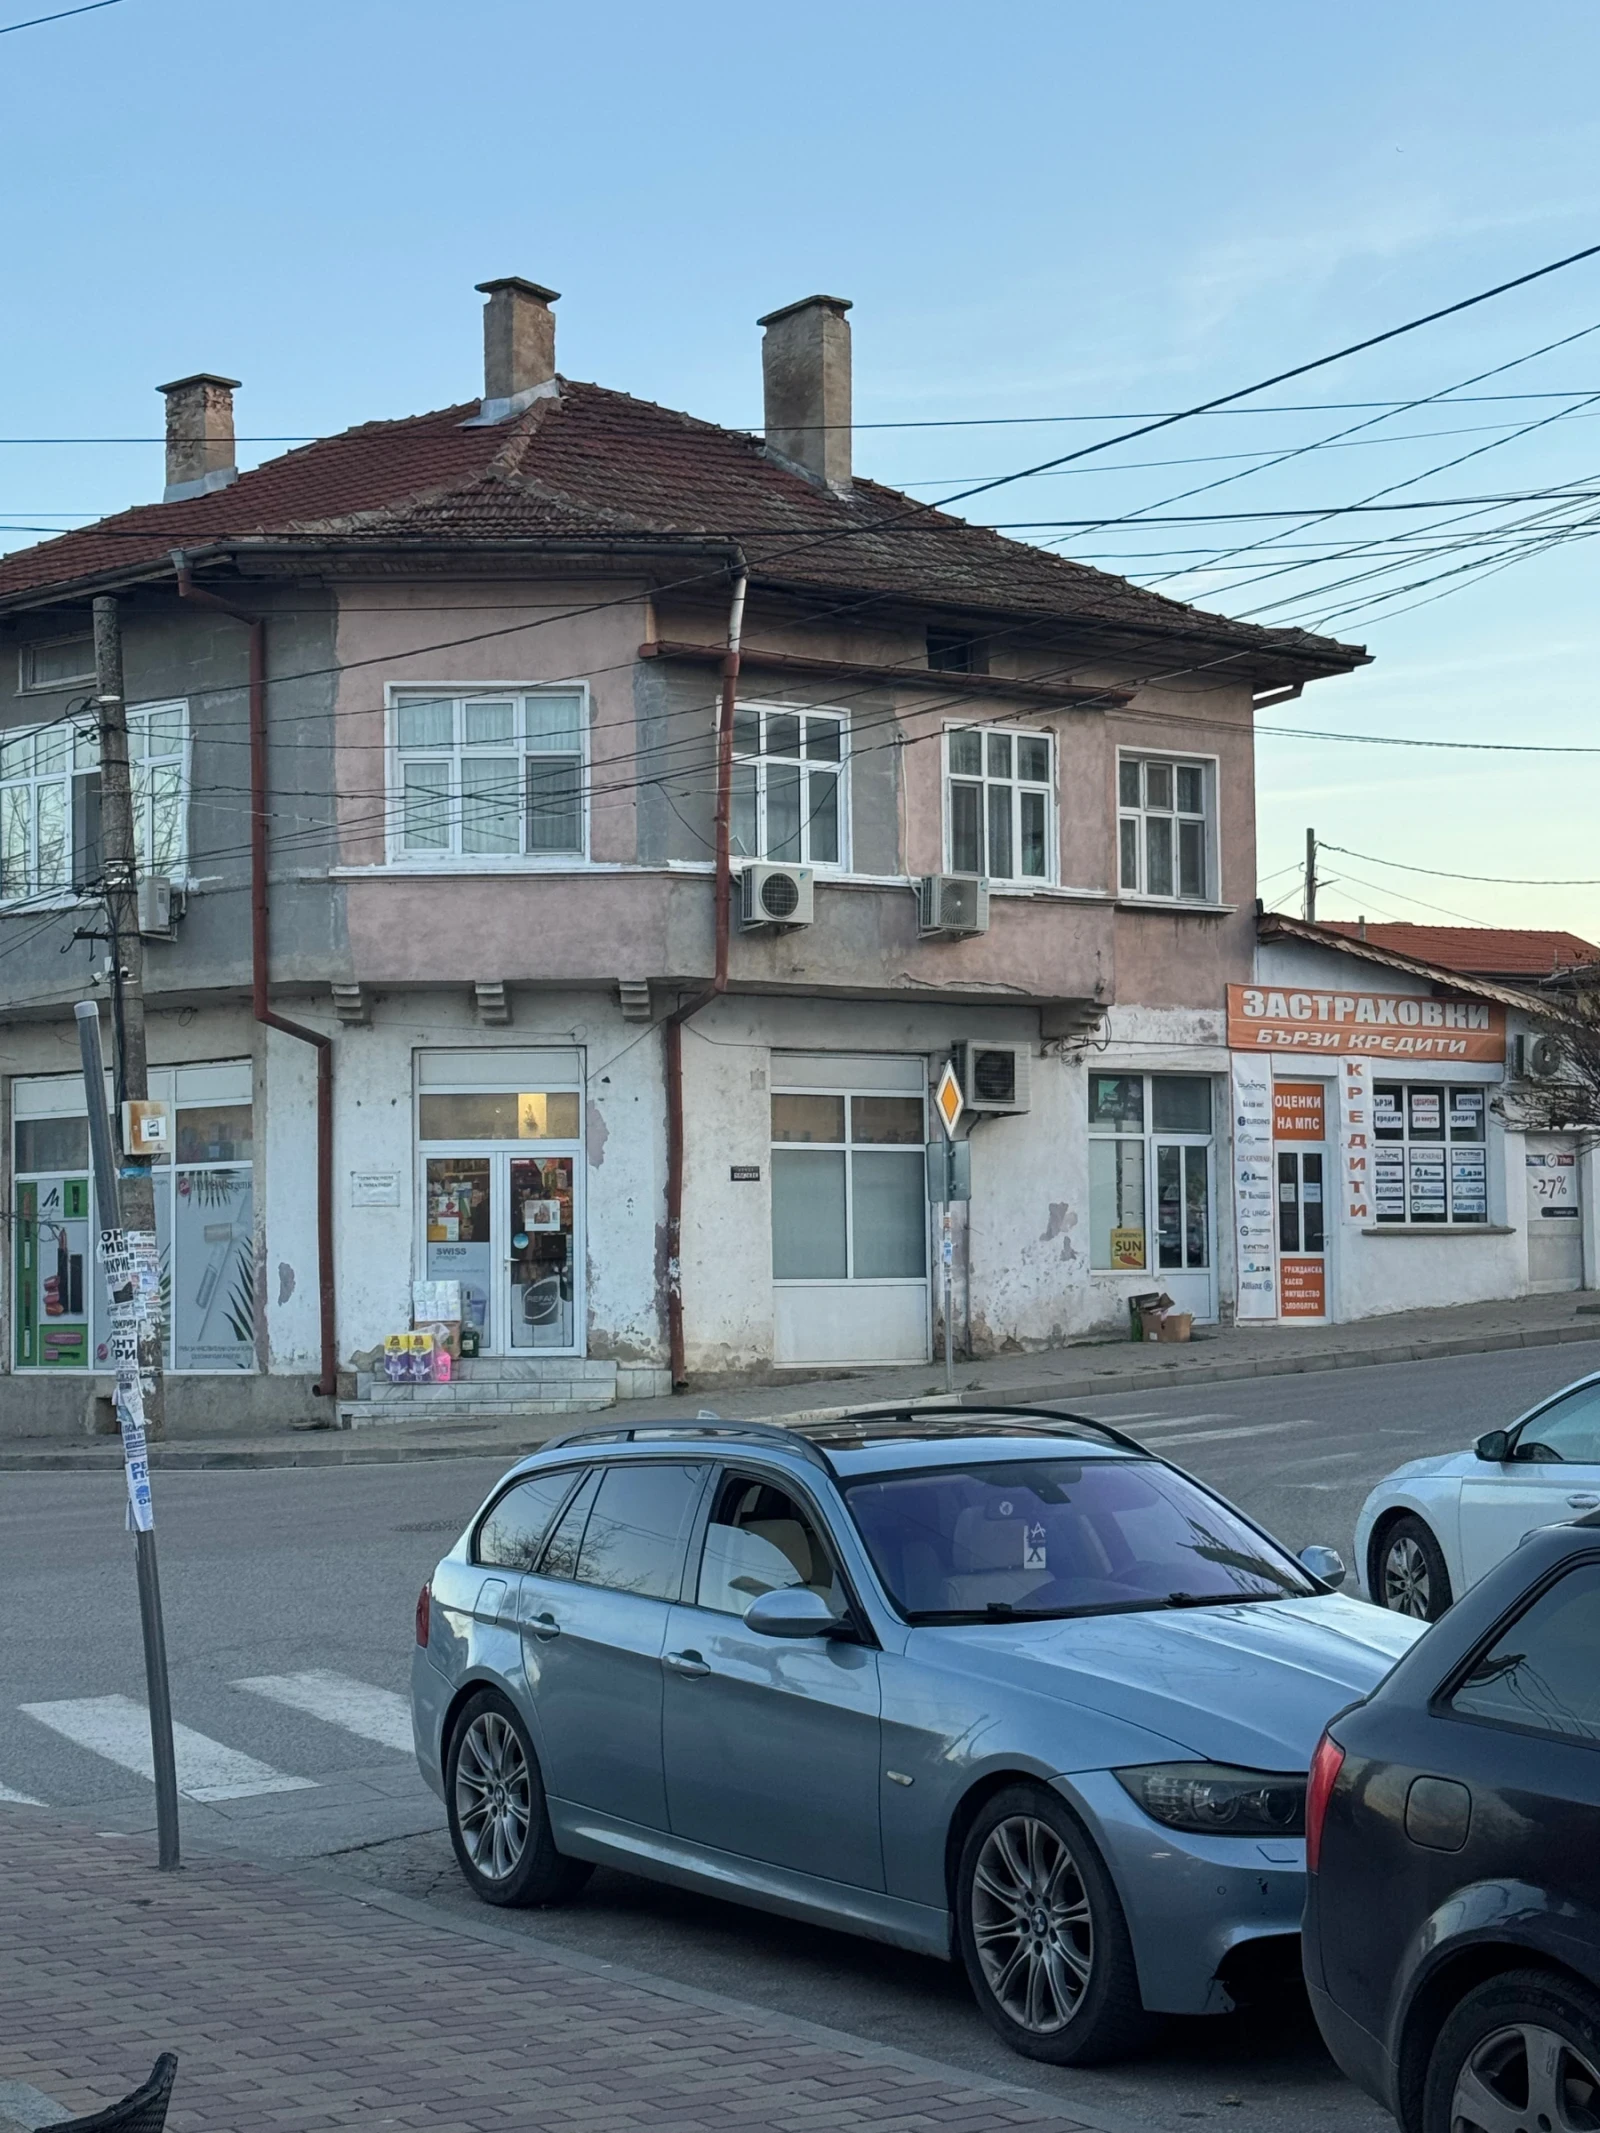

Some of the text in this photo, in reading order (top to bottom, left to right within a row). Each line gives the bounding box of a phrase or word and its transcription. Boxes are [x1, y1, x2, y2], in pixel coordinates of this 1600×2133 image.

[1242, 990, 1489, 1030] ЗАСТРАХОВКИ
[1256, 1029, 1467, 1054] БЪРЗИ КРЕДИТИ
[1274, 1095, 1321, 1110] ОЦЕНКИ
[1374, 1098, 1392, 1107] ЪРЗИ
[1277, 1116, 1320, 1130] НА МПС
[1346, 1063, 1367, 1217] КРЕДИТИ
[1533, 1176, 1567, 1199] -27%
[436, 1247, 467, 1256] SWISS
[1115, 1241, 1142, 1252] SUN
